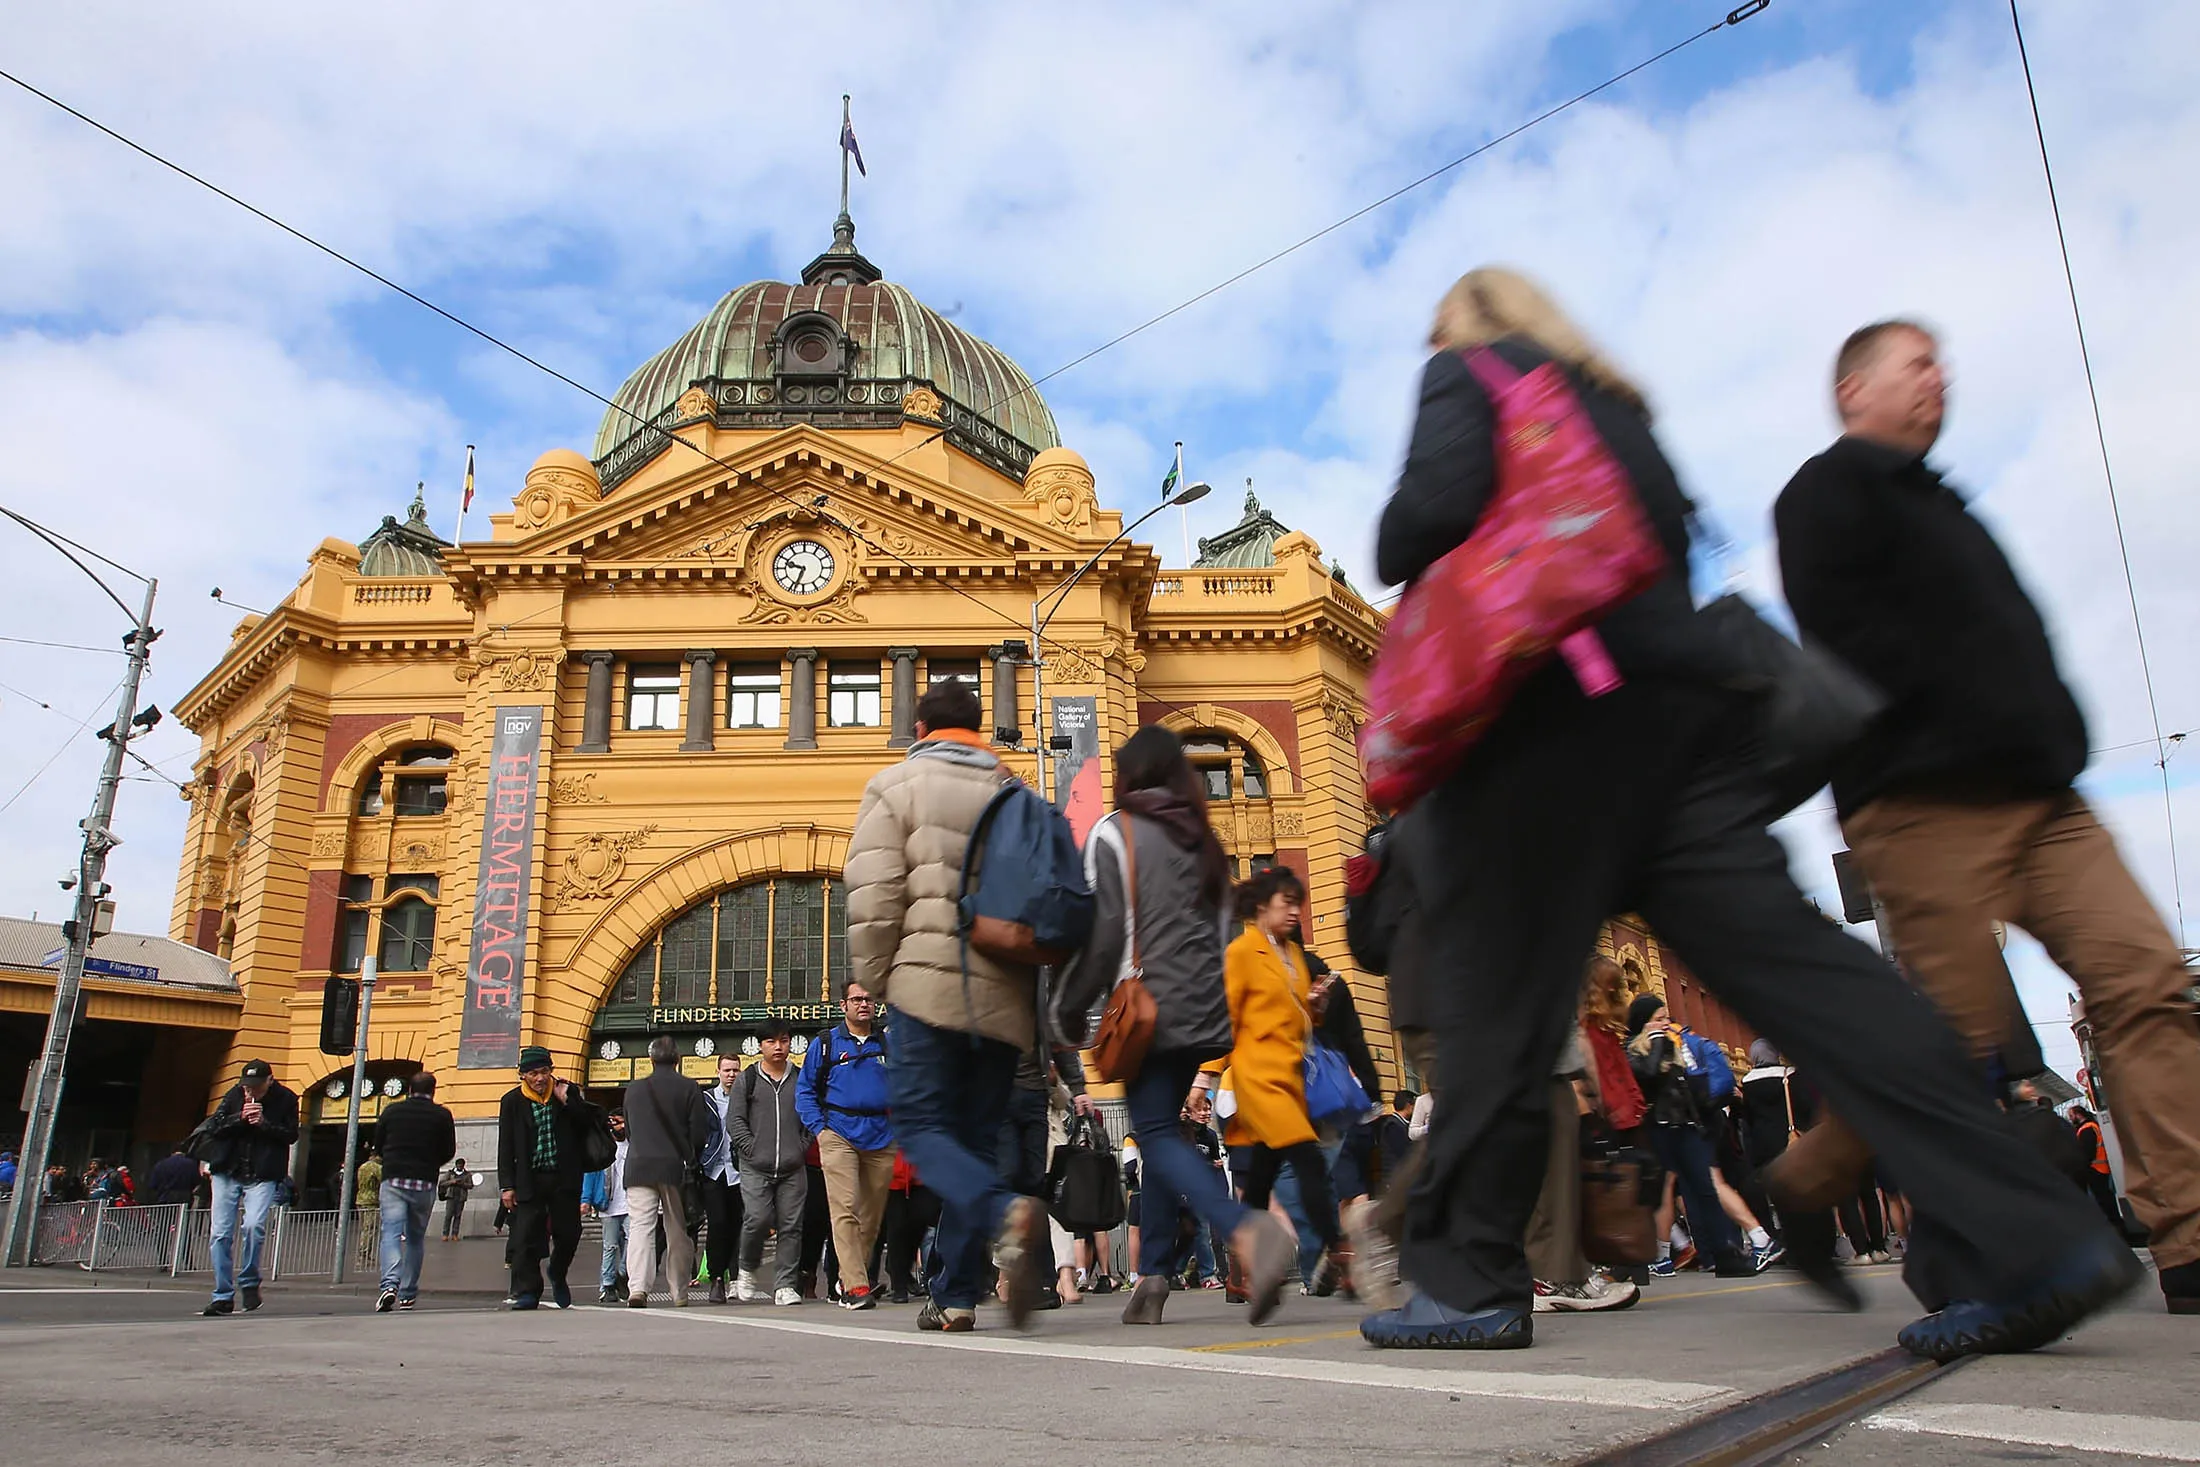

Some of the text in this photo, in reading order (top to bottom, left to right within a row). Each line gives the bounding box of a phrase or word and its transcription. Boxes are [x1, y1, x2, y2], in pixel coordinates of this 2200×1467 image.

[1058, 705, 1086, 713] National
[1058, 713, 1083, 723] Gallery
[506, 719, 532, 734] ngv
[476, 752, 531, 1010] HERMITAGE
[109, 962, 144, 975] Flinders
[147, 968, 156, 977] St
[653, 1005, 833, 1023] FLINDERS STREET
